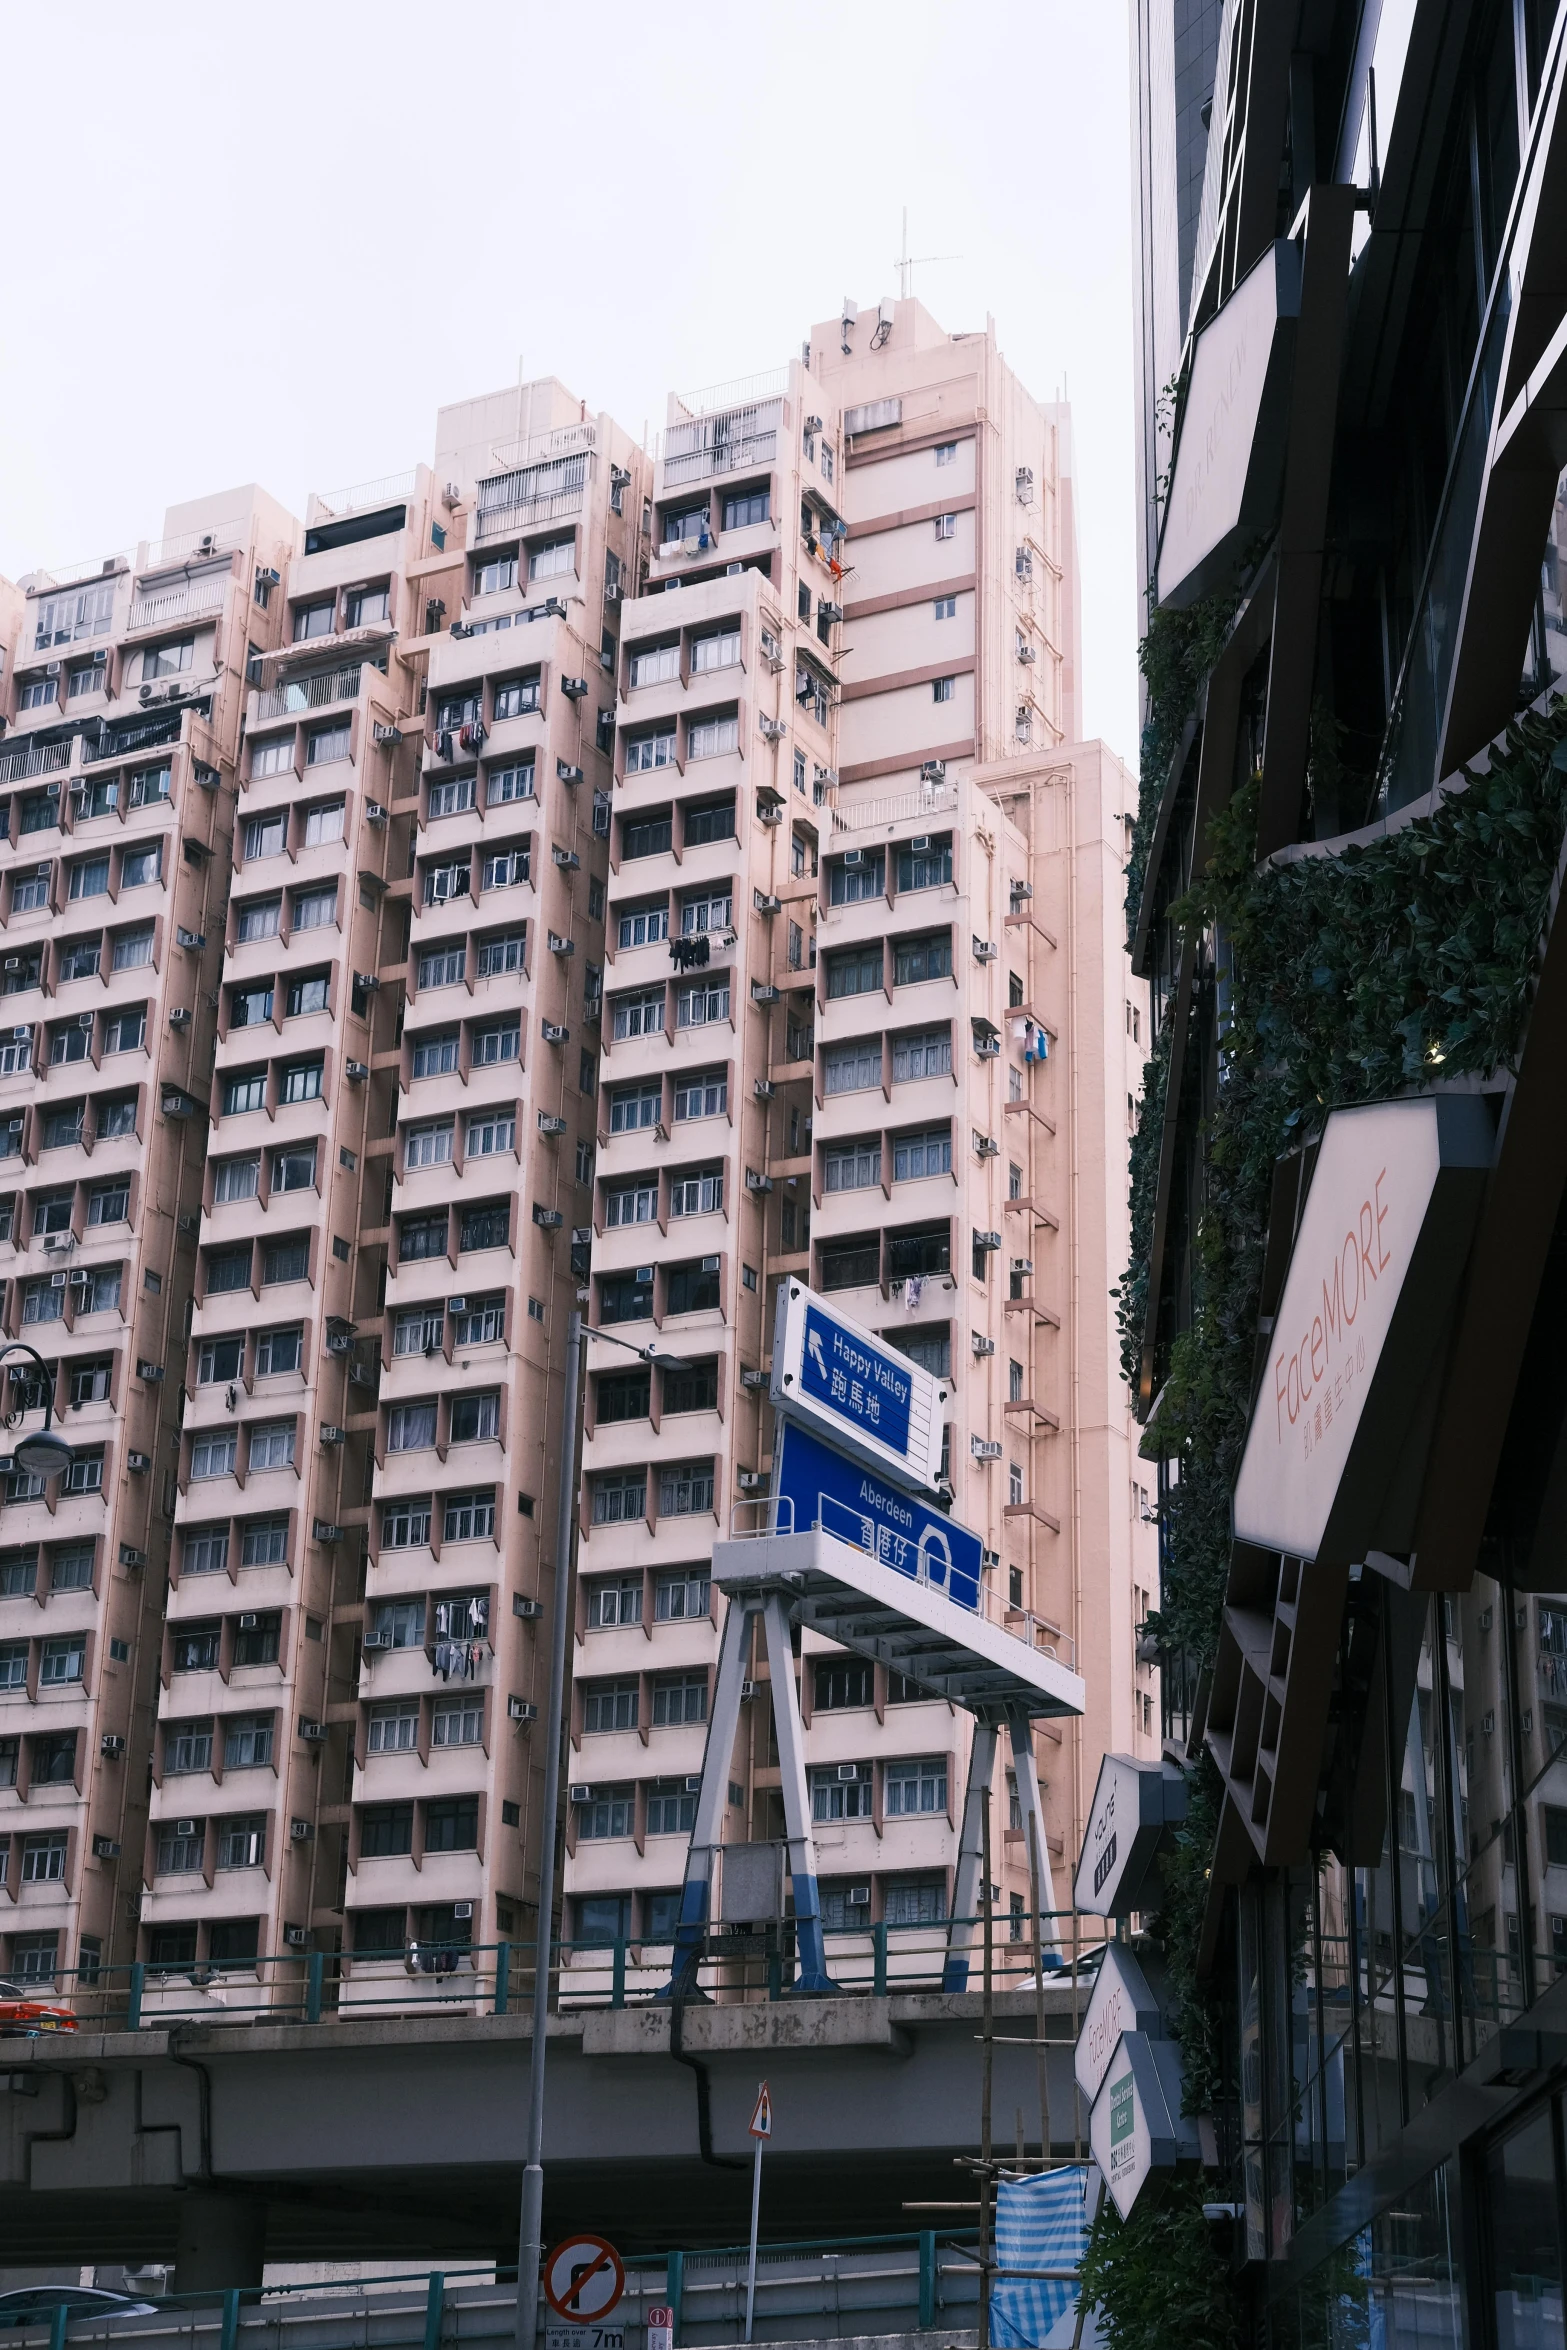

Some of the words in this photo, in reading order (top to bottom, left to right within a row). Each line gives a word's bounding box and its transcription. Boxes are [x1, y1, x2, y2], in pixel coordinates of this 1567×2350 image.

[1206, 312, 1248, 474] RENEW
[1275, 1166, 1391, 1444] FaceMORE
[833, 1332, 872, 1376] Happy
[874, 1359, 908, 1404] Valley
[830, 1367, 880, 1425] 跑馬地
[859, 1480, 913, 1529] Aberdeen
[860, 1516, 908, 1567] 香港仔
[1088, 1987, 1122, 2068] FaceMORE
[1110, 2089, 1122, 2110] Dental
[1121, 2081, 1134, 2104] Service
[546, 2329, 570, 2337] Length
[591, 2329, 623, 2349] 7m
